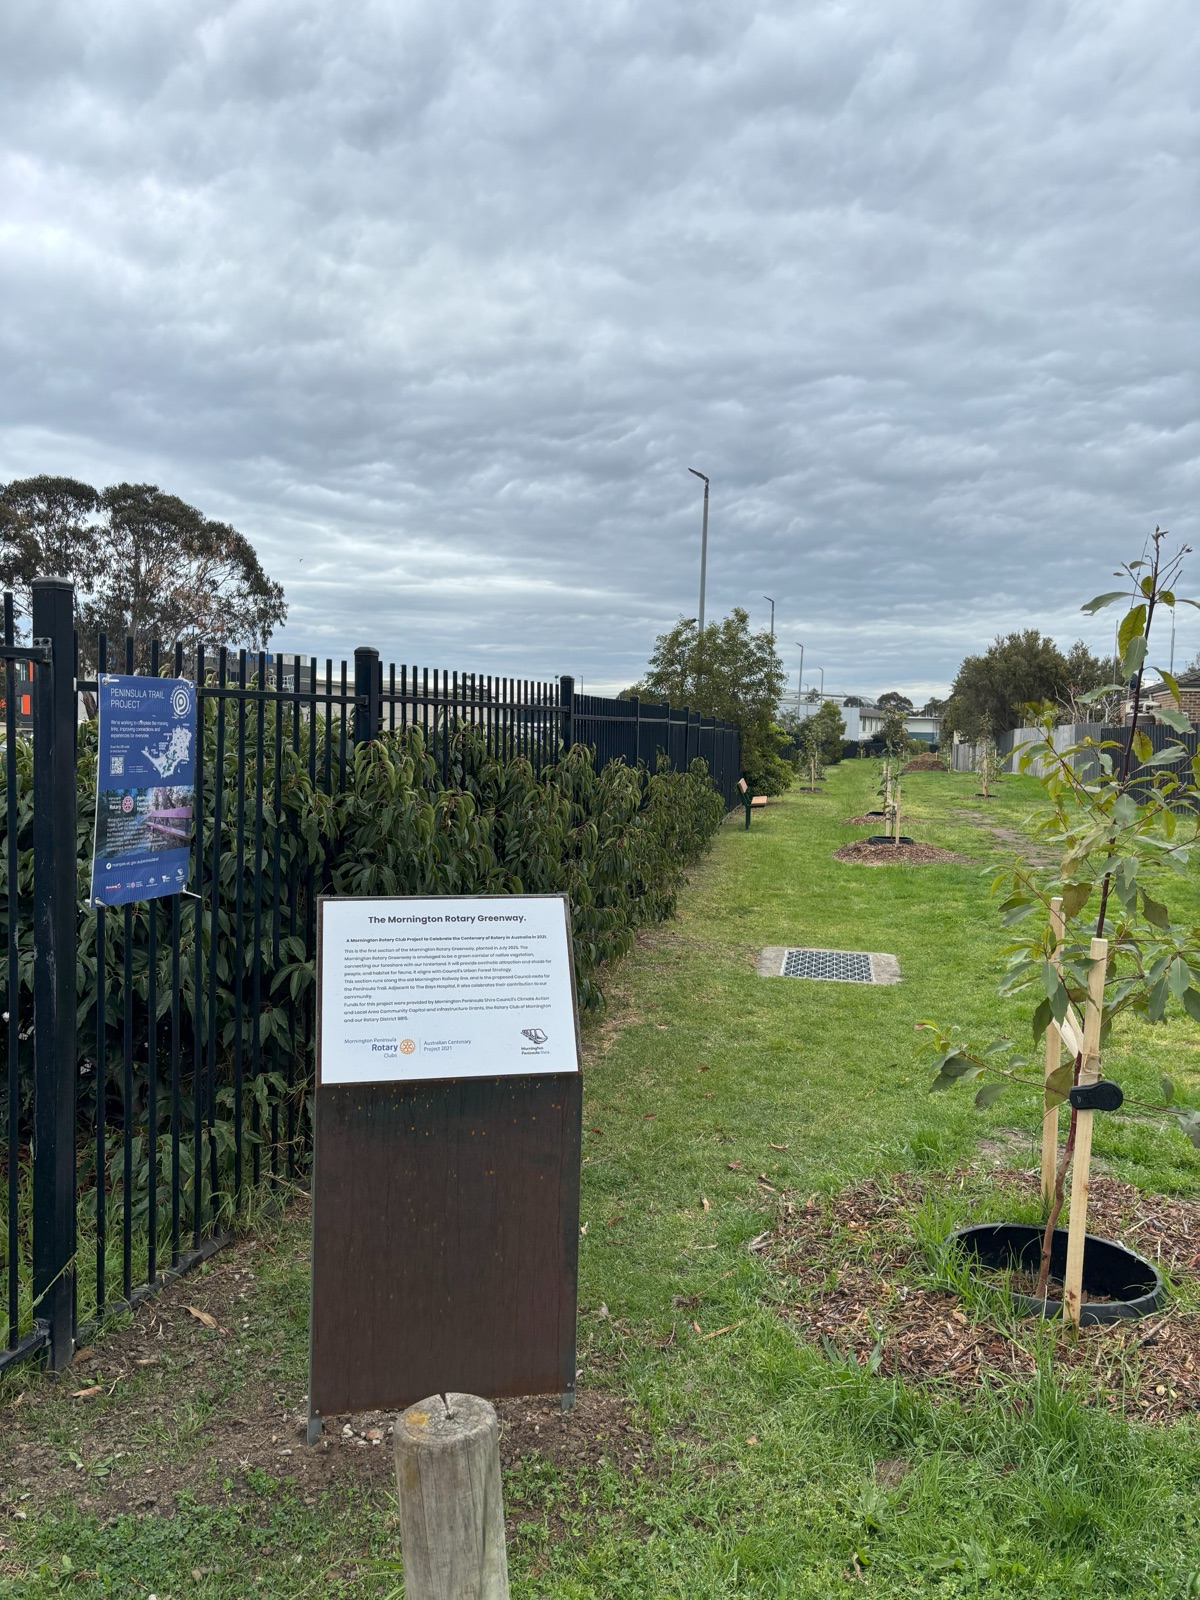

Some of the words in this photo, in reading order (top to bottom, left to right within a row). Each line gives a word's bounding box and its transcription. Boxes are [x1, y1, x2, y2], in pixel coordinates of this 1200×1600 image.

[110, 687, 147, 699] PENINSULA
[148, 690, 165, 699] TRAIL
[110, 699, 140, 709] PROJECT
[368, 916, 386, 924] The
[388, 915, 443, 925] Mornington
[445, 915, 476, 924] Rotary
[477, 914, 527, 923] Greenway.
[371, 1044, 399, 1053] Rotary
